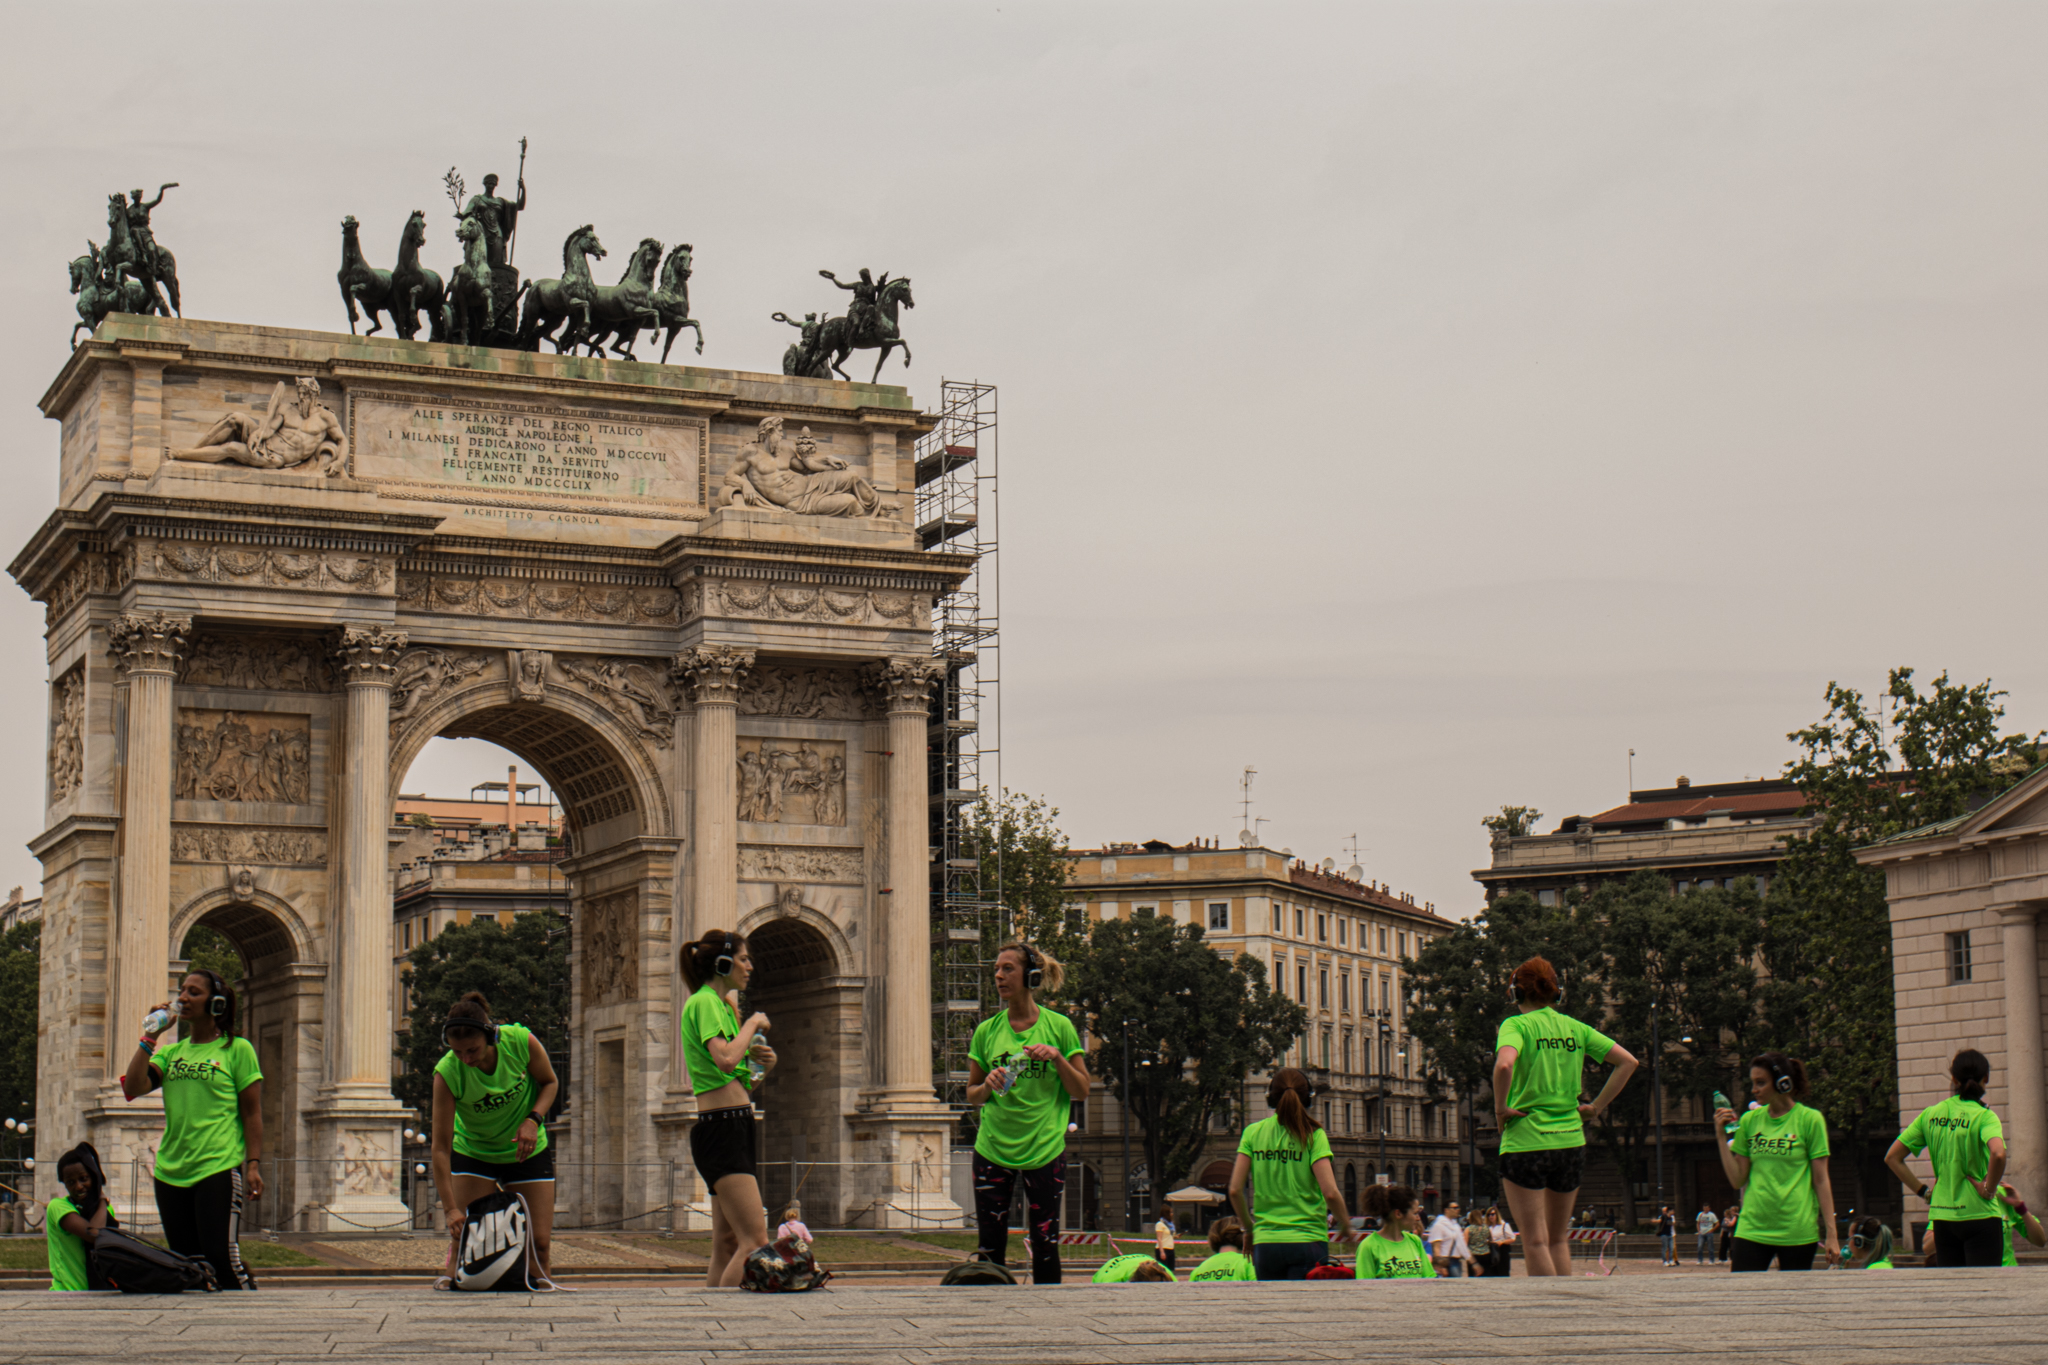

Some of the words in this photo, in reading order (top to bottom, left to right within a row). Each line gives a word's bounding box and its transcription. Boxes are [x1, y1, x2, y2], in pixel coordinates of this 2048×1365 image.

[414, 409, 443, 420] ALLE
[452, 412, 514, 426] SPERANZE
[523, 418, 544, 429] DEL
[553, 420, 590, 432] REGNO
[599, 424, 643, 437] ITALICO
[466, 425, 508, 437] AUSPICE
[517, 430, 580, 443] NAPOLEONE
[388, 430, 393, 439] I
[401, 431, 460, 445] MILANESI
[469, 437, 546, 451] DEDICARONO
[567, 446, 598, 456] ANNO
[607, 448, 667, 462] MDCCCVII
[453, 447, 459, 457] E
[468, 449, 527, 462] FRANCATI
[538, 454, 553, 464] DA
[562, 456, 609, 469] SERVITU
[443, 458, 523, 473] FELICEMENTE
[532, 466, 620, 481] RESTITUIRONO
[482, 474, 516, 484] ANNO
[524, 476, 592, 490] MDCCCLIX
[464, 508, 533, 520] ARCHITETTO
[549, 513, 600, 525] CAGNOLA
[166, 1071, 216, 1082] ORKOUT
[1252, 1149, 1303, 1164] mengiu
